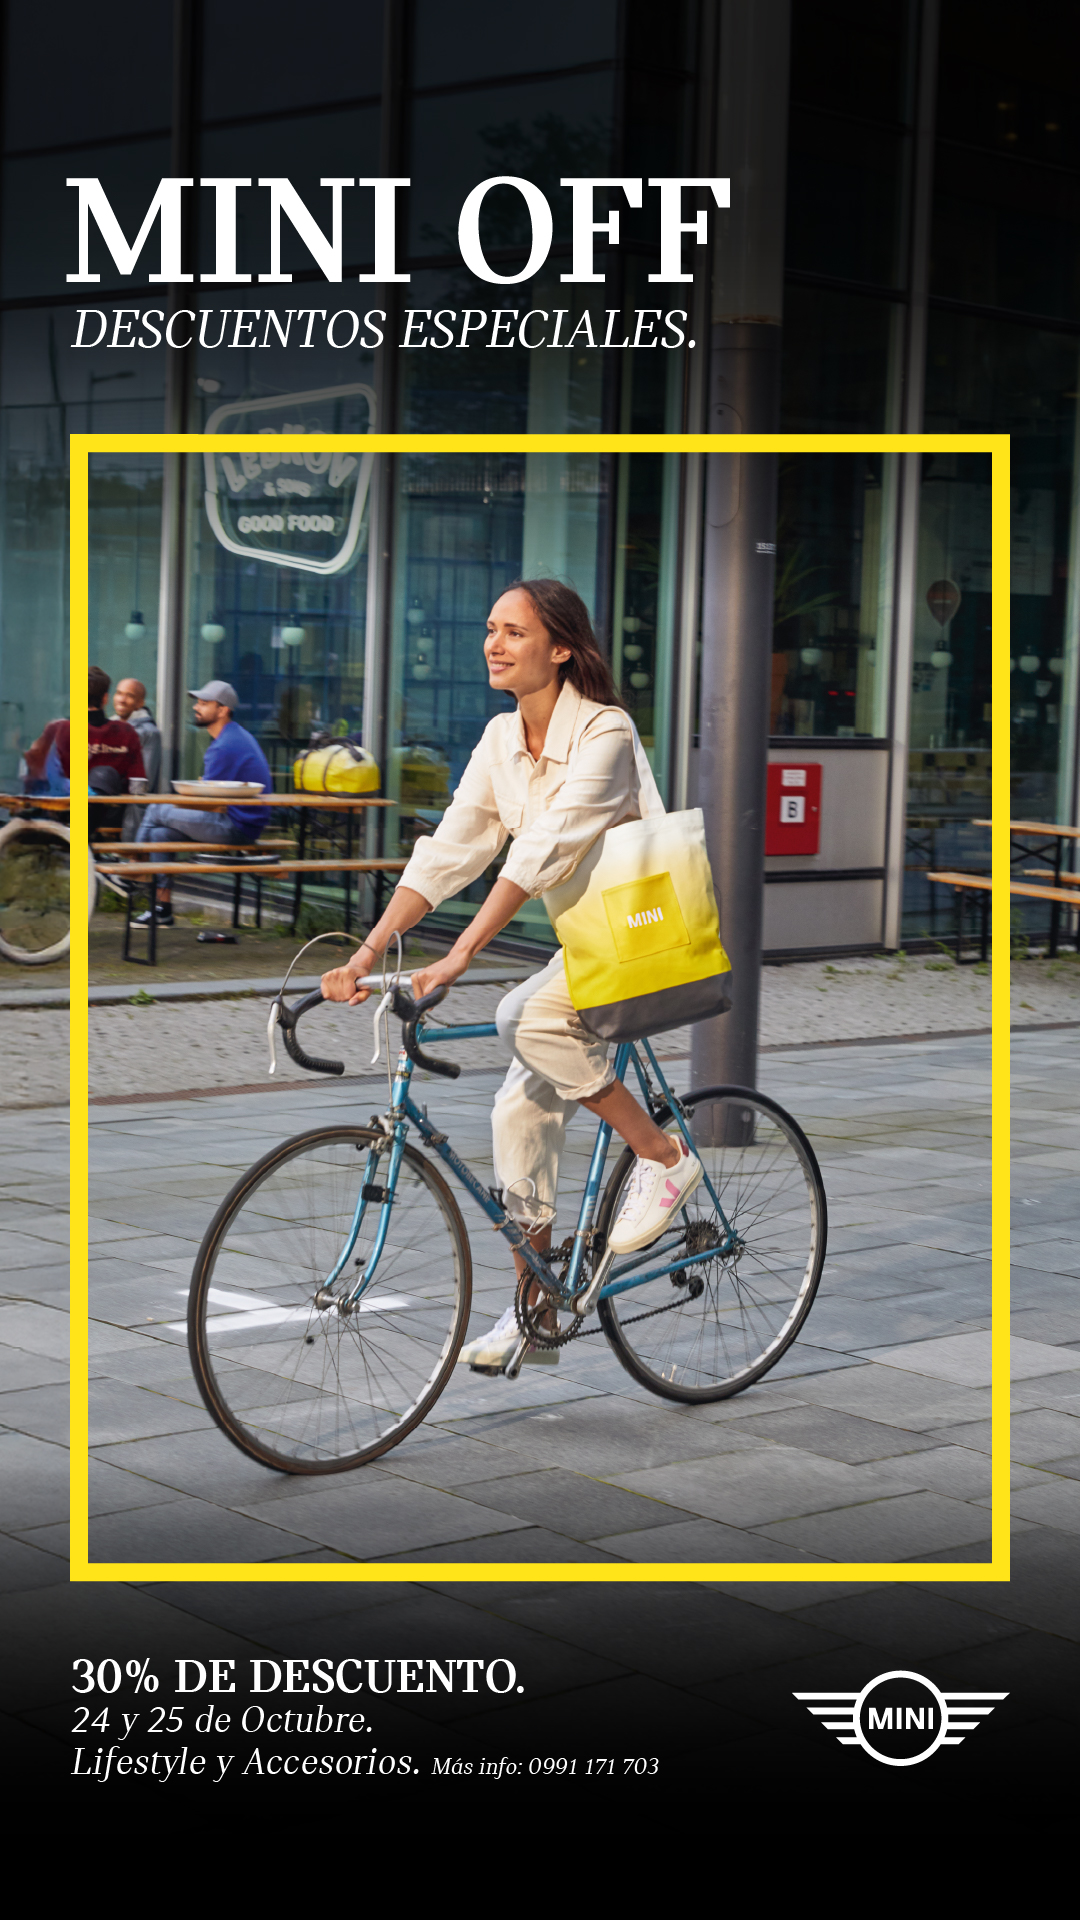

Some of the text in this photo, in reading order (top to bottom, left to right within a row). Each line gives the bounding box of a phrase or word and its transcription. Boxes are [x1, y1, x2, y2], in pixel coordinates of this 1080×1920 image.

[238, 514, 335, 533] GOOD FOOD
[787, 801, 798, 818] B
[626, 906, 664, 929] MINI
